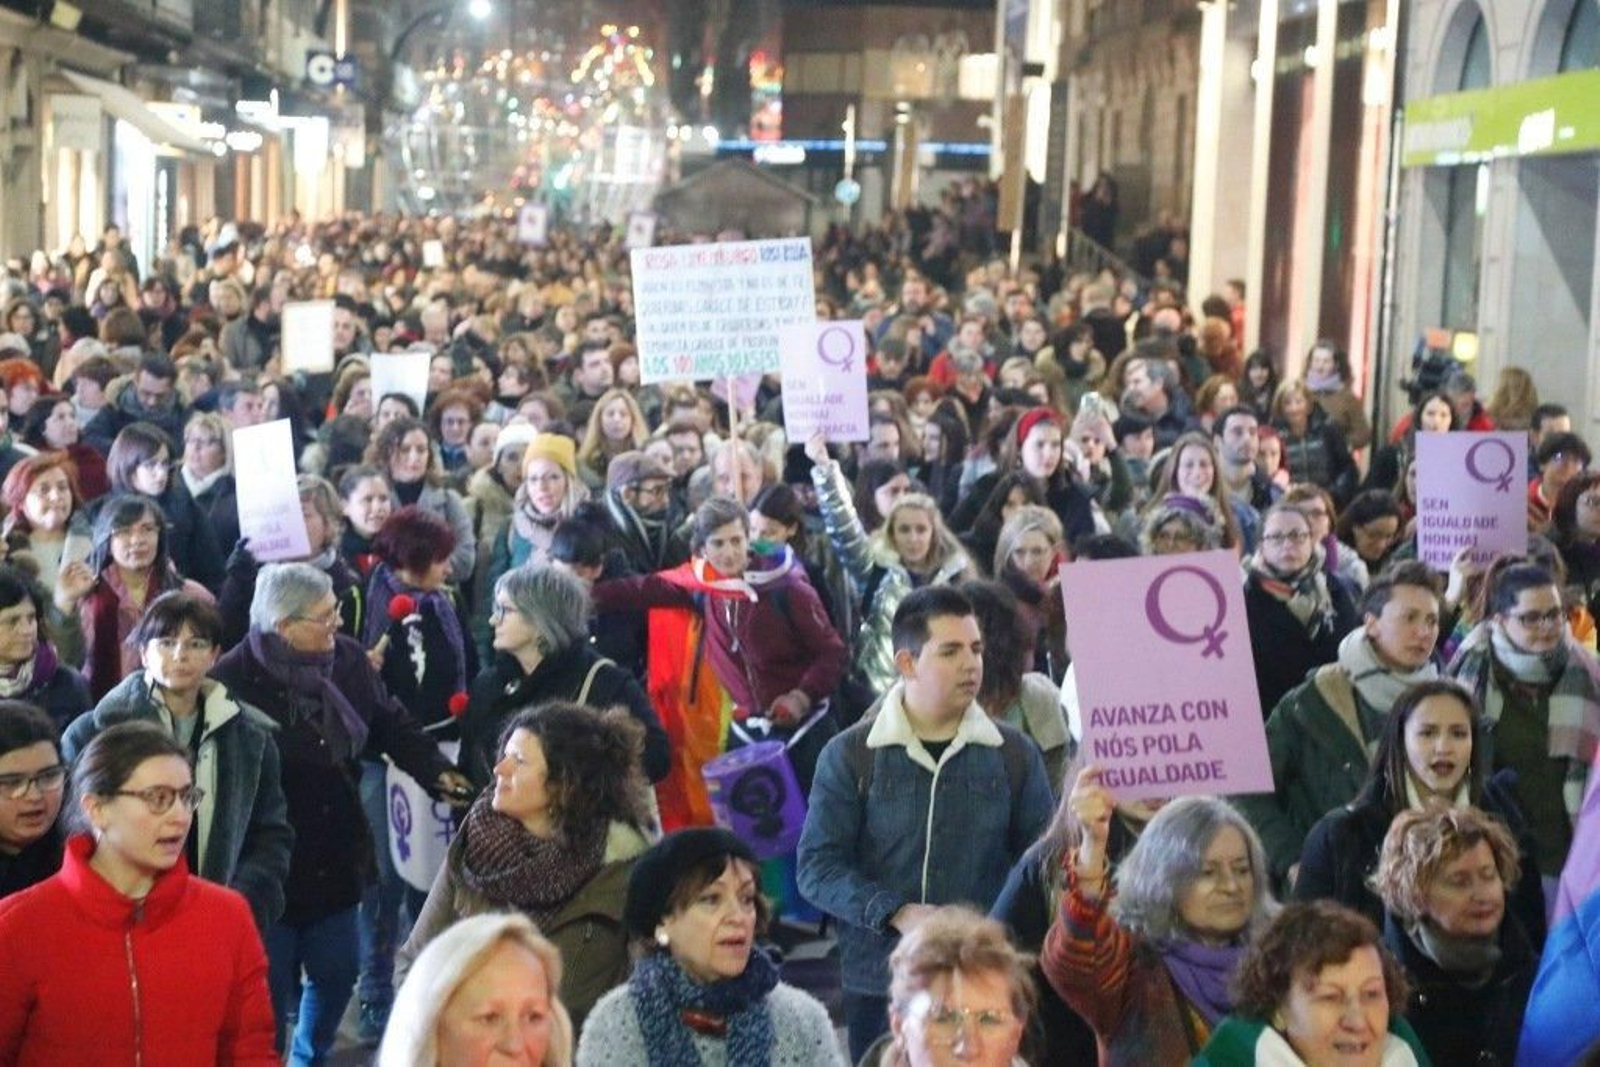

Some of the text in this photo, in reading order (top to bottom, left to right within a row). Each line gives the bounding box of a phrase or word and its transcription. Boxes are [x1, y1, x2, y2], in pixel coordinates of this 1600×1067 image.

[1422, 499, 1448, 510] SEN
[1424, 533, 1450, 545] NON
[1090, 699, 1229, 728] AVANZA CON
[1093, 732, 1202, 758] NÓS POLA
